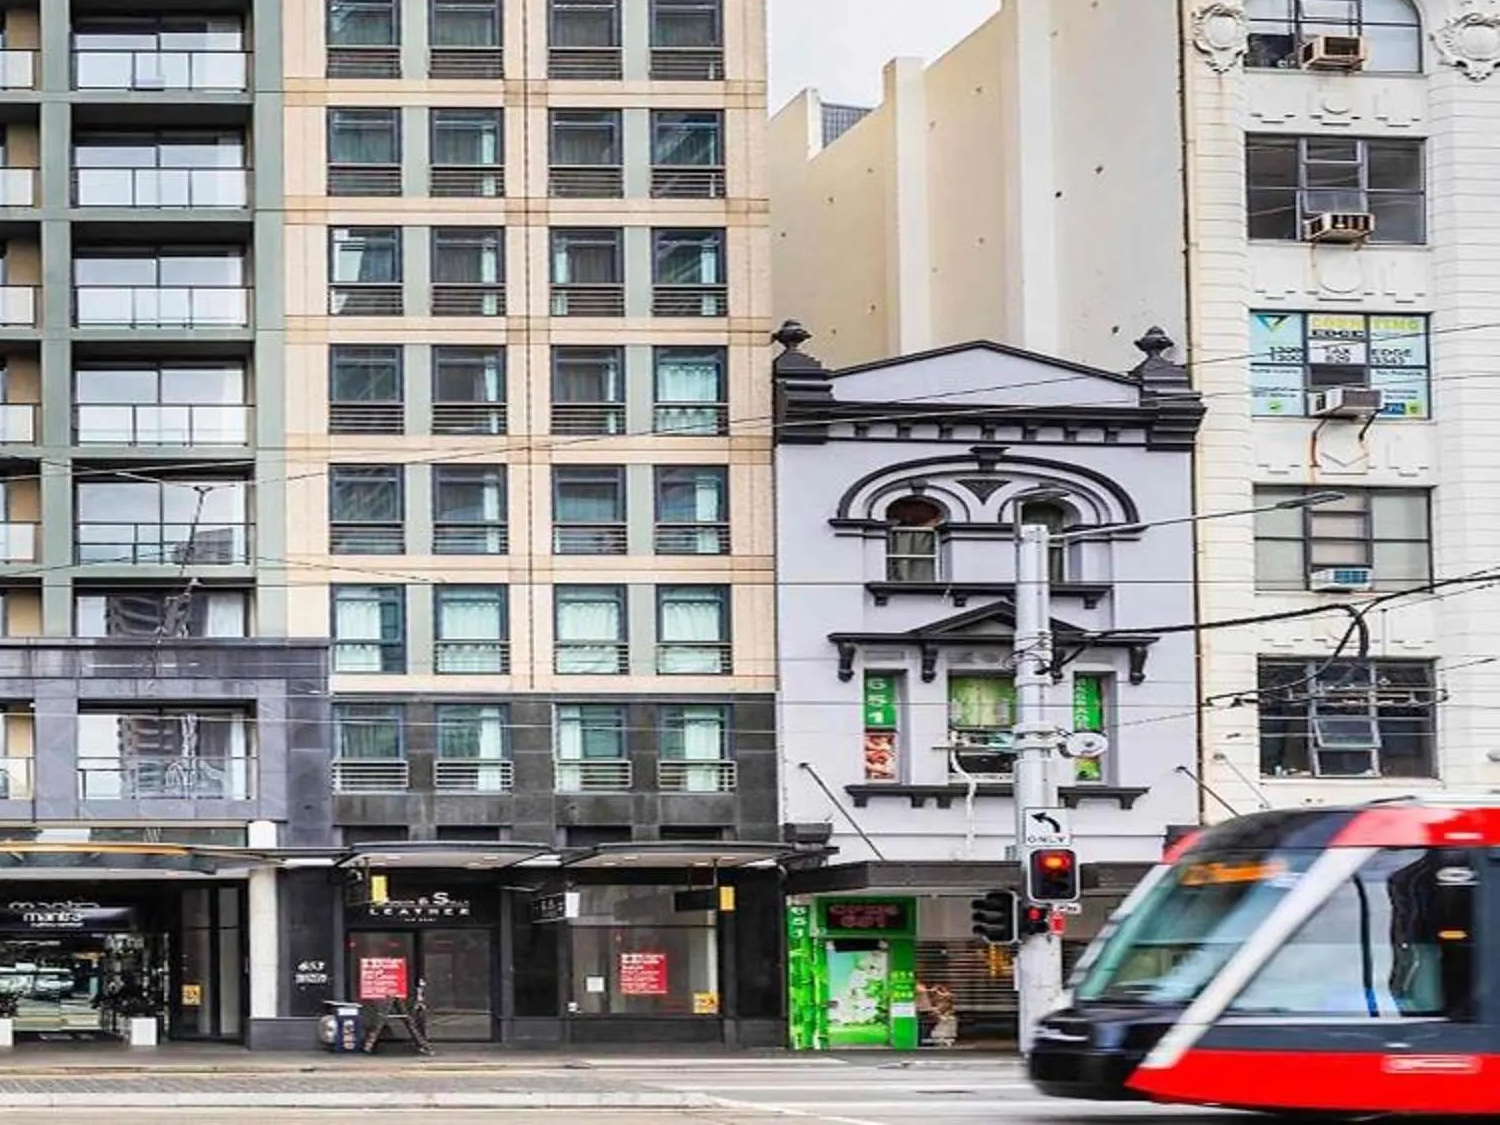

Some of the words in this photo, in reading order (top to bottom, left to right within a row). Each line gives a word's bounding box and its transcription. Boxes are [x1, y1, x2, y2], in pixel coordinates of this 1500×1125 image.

[867, 677, 888, 724] 651
[1027, 836, 1065, 844] ONLY
[23, 911, 82, 922] mantra
